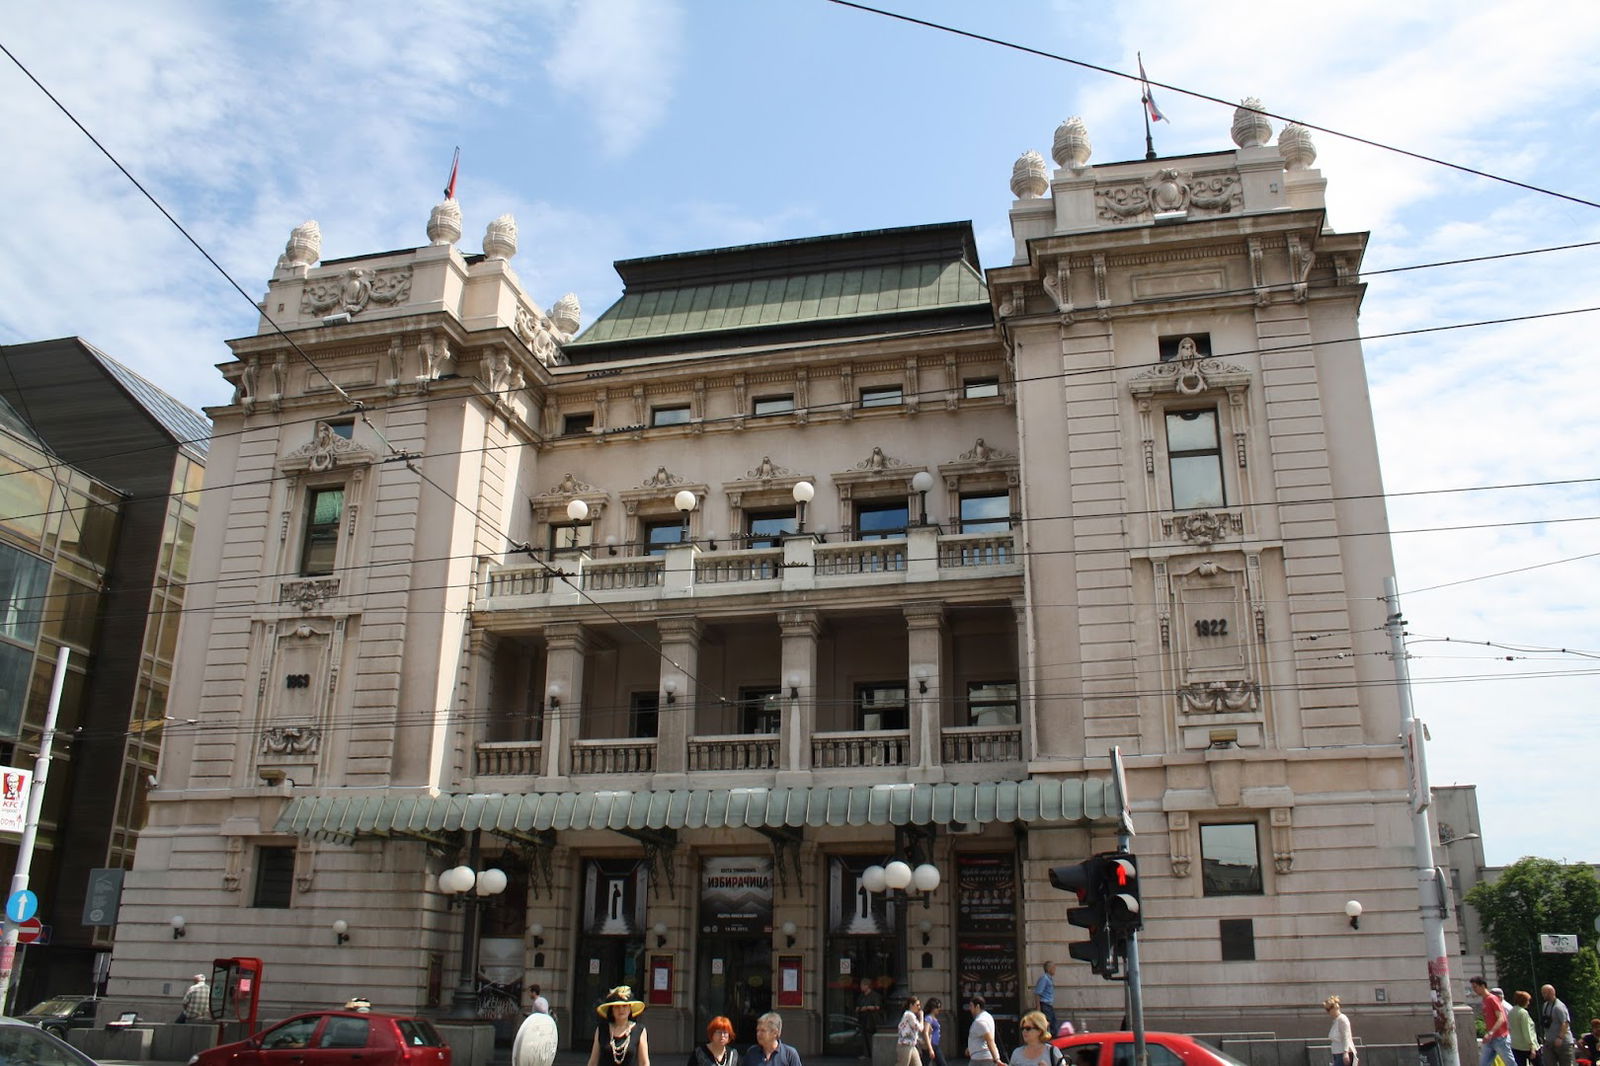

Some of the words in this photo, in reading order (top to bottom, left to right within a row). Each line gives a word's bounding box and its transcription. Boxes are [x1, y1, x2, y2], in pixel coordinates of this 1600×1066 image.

[1194, 619, 1228, 637] 1922
[3, 800, 19, 808] KFC
[708, 876, 769, 889] ИЗБИРАЧИЦА
